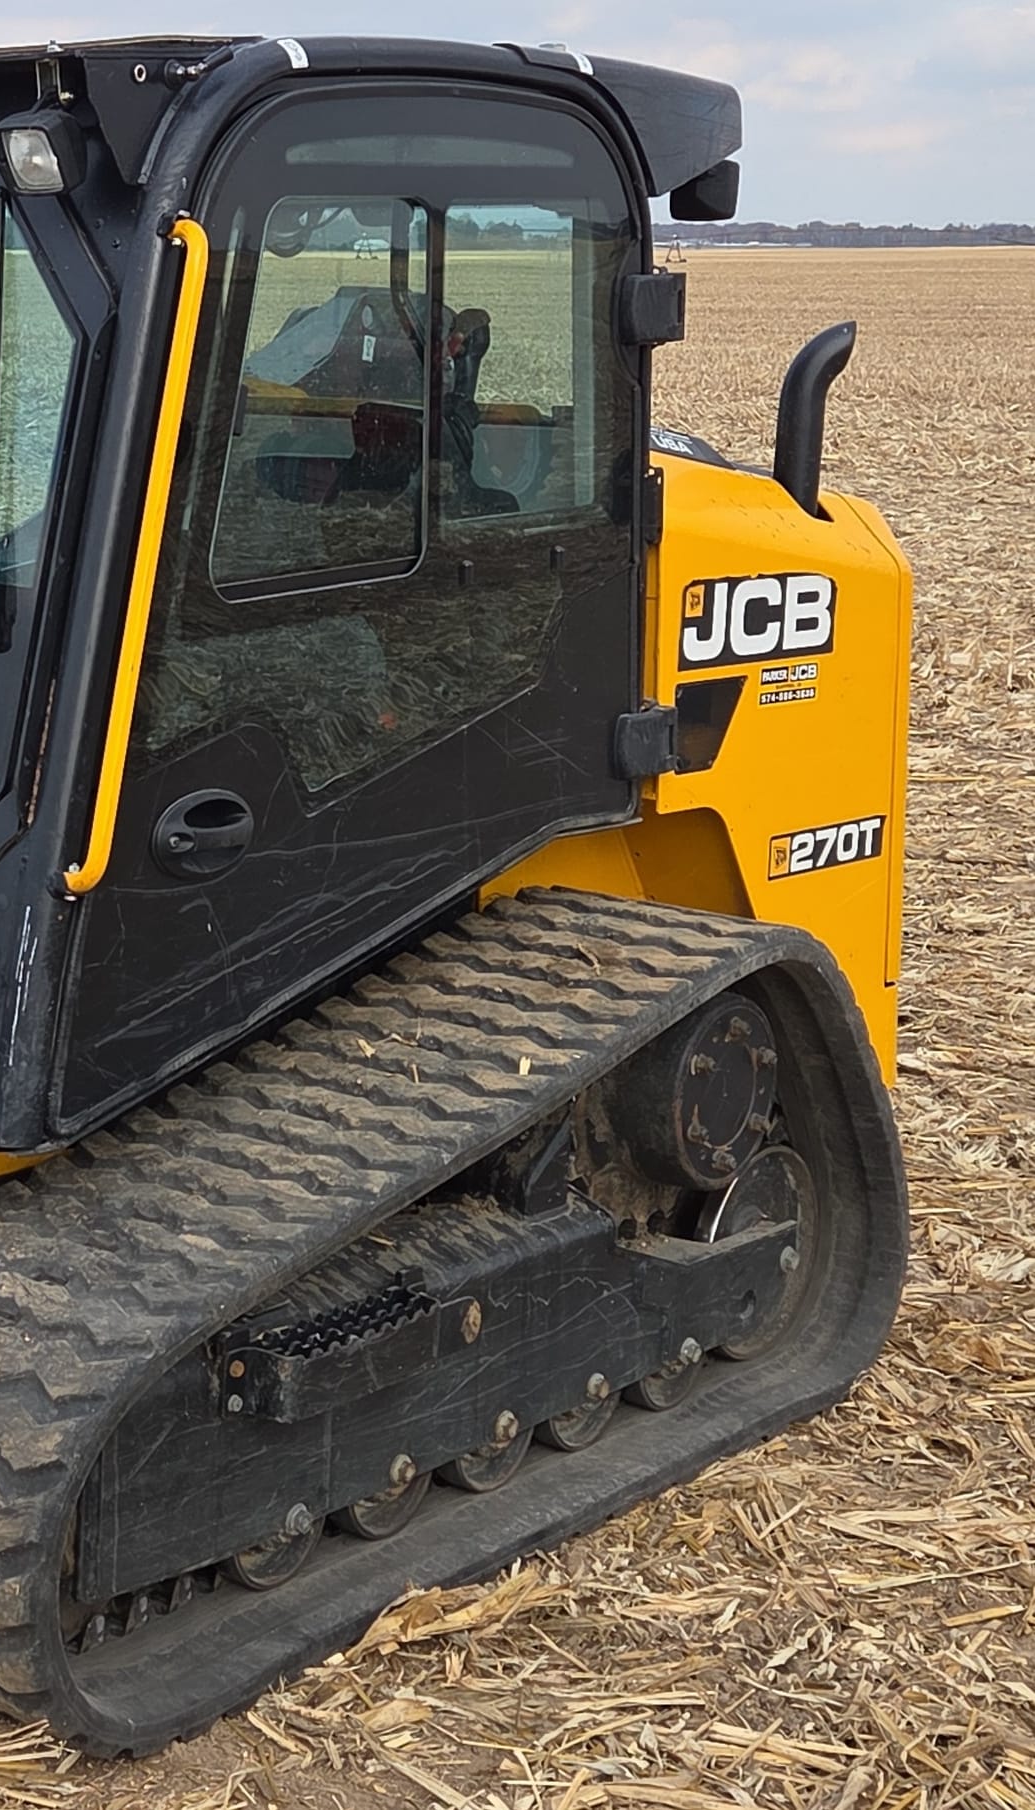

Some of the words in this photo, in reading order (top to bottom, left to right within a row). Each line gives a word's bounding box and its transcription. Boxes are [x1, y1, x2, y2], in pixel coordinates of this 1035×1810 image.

[682, 575, 832, 662] JCB
[790, 664, 817, 681] JCB
[790, 818, 881, 873] 270T
